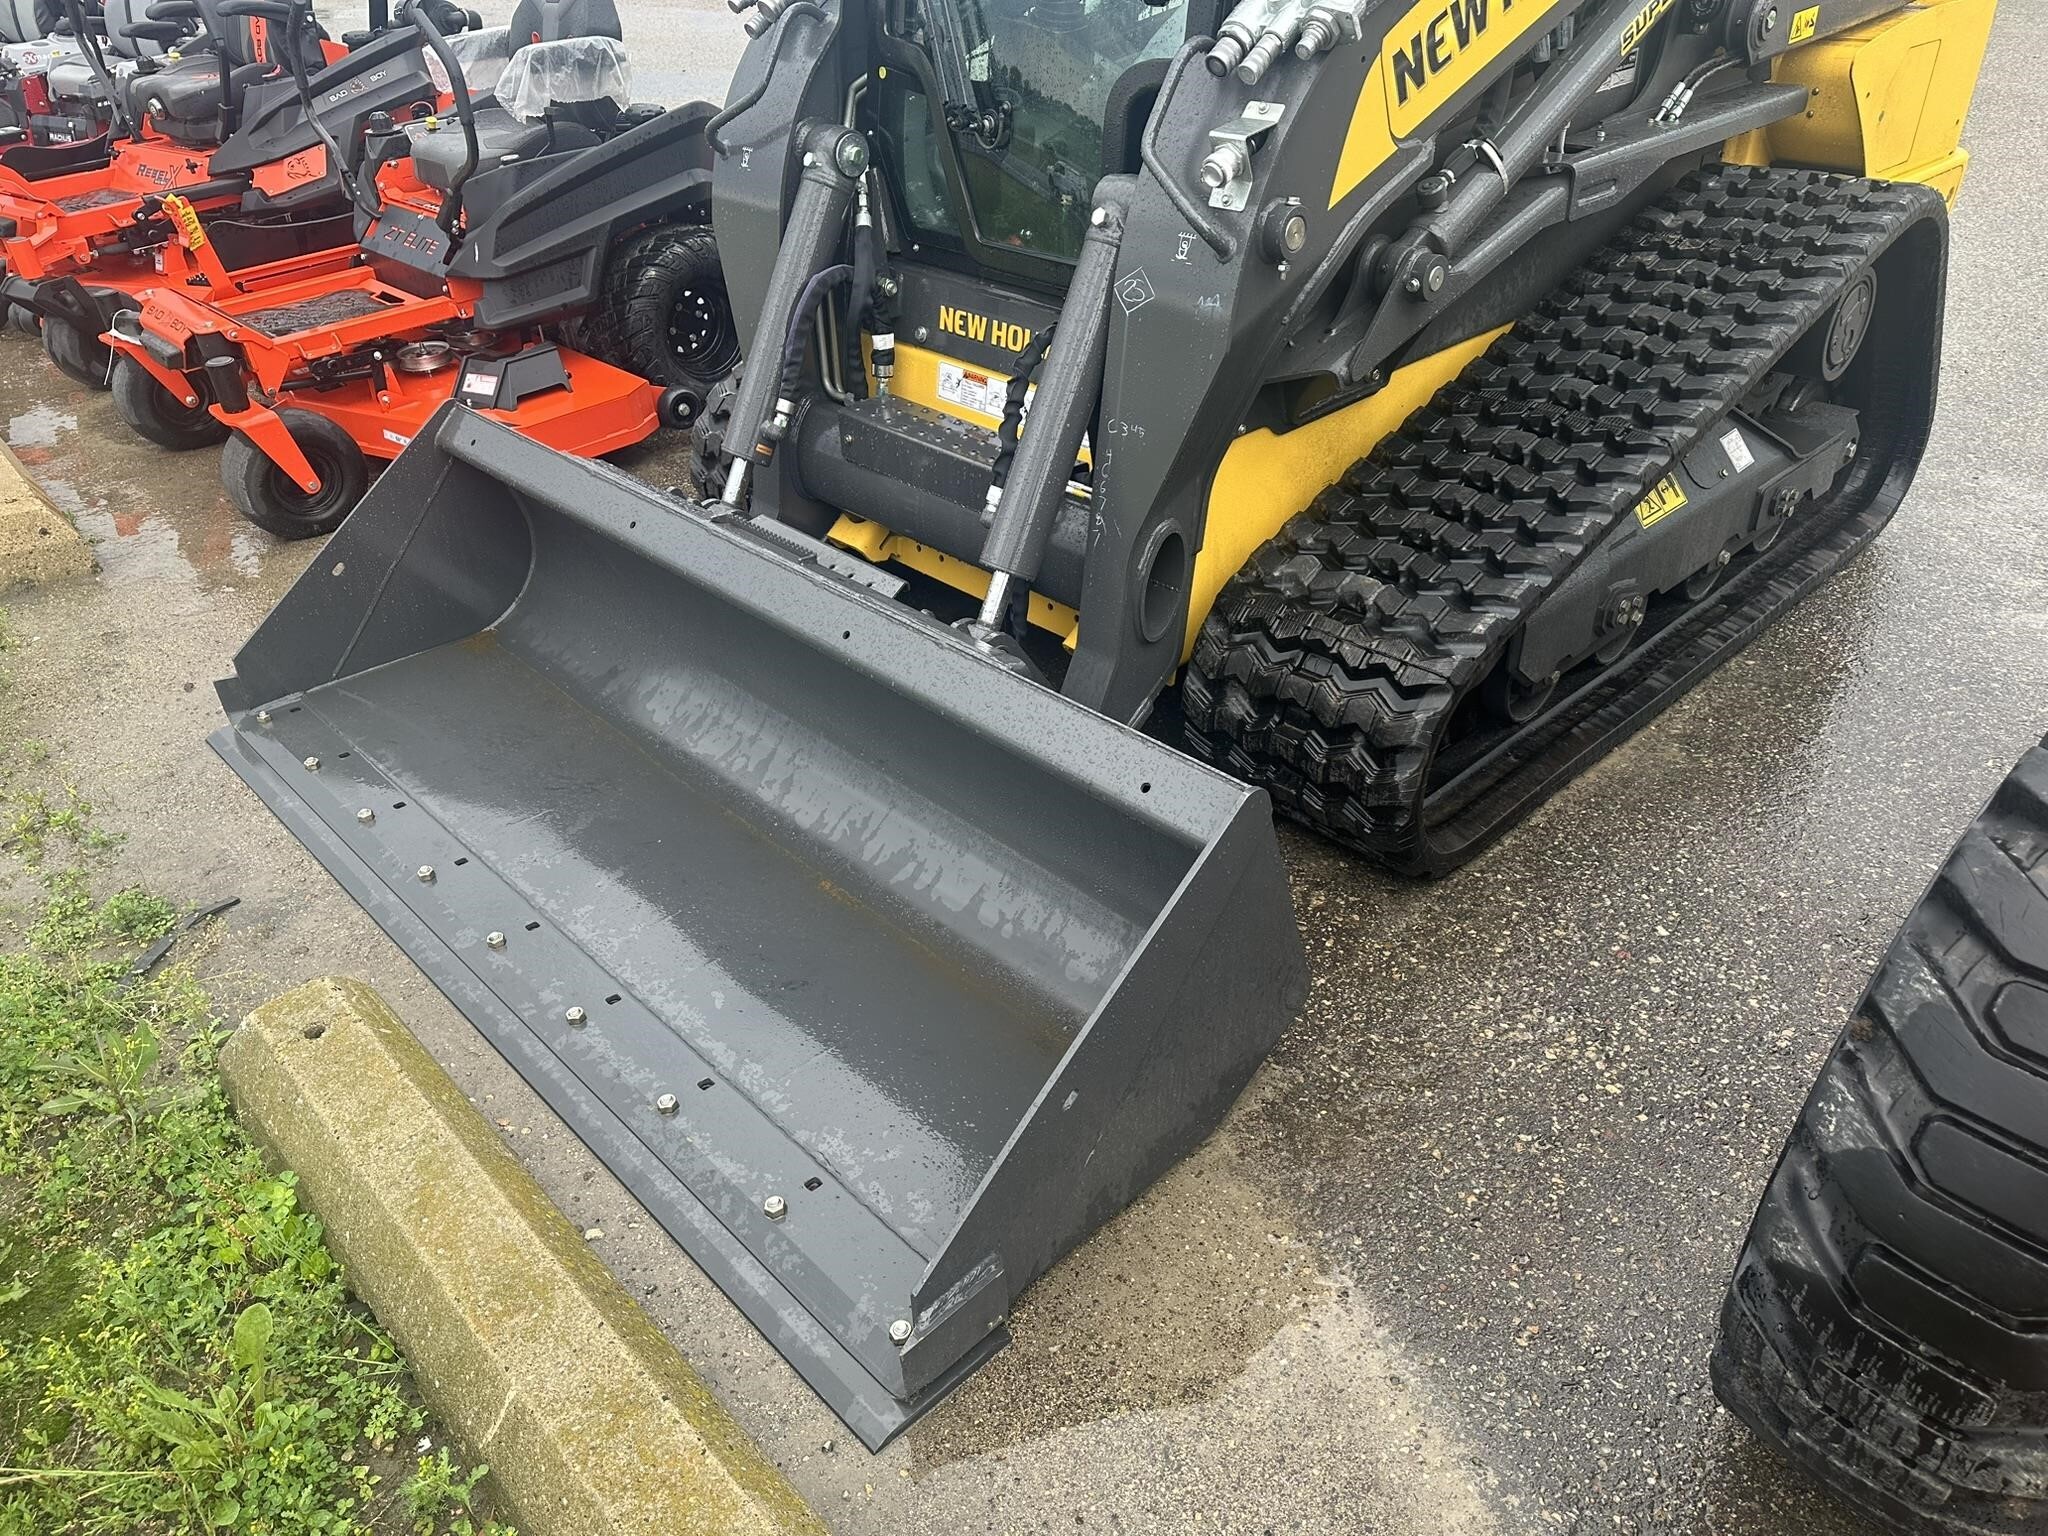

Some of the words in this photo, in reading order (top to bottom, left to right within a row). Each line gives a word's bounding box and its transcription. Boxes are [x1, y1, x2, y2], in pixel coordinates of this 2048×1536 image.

[1621, 0, 1674, 56] SUP
[1392, 0, 1488, 108] NEW
[329, 89, 348, 102] BAD
[370, 70, 387, 82] BOY
[384, 225, 406, 241] ZT
[403, 231, 440, 255] ELITE
[146, 305, 165, 320] BAD
[169, 318, 189, 333] BOY
[939, 304, 988, 342] NEW
